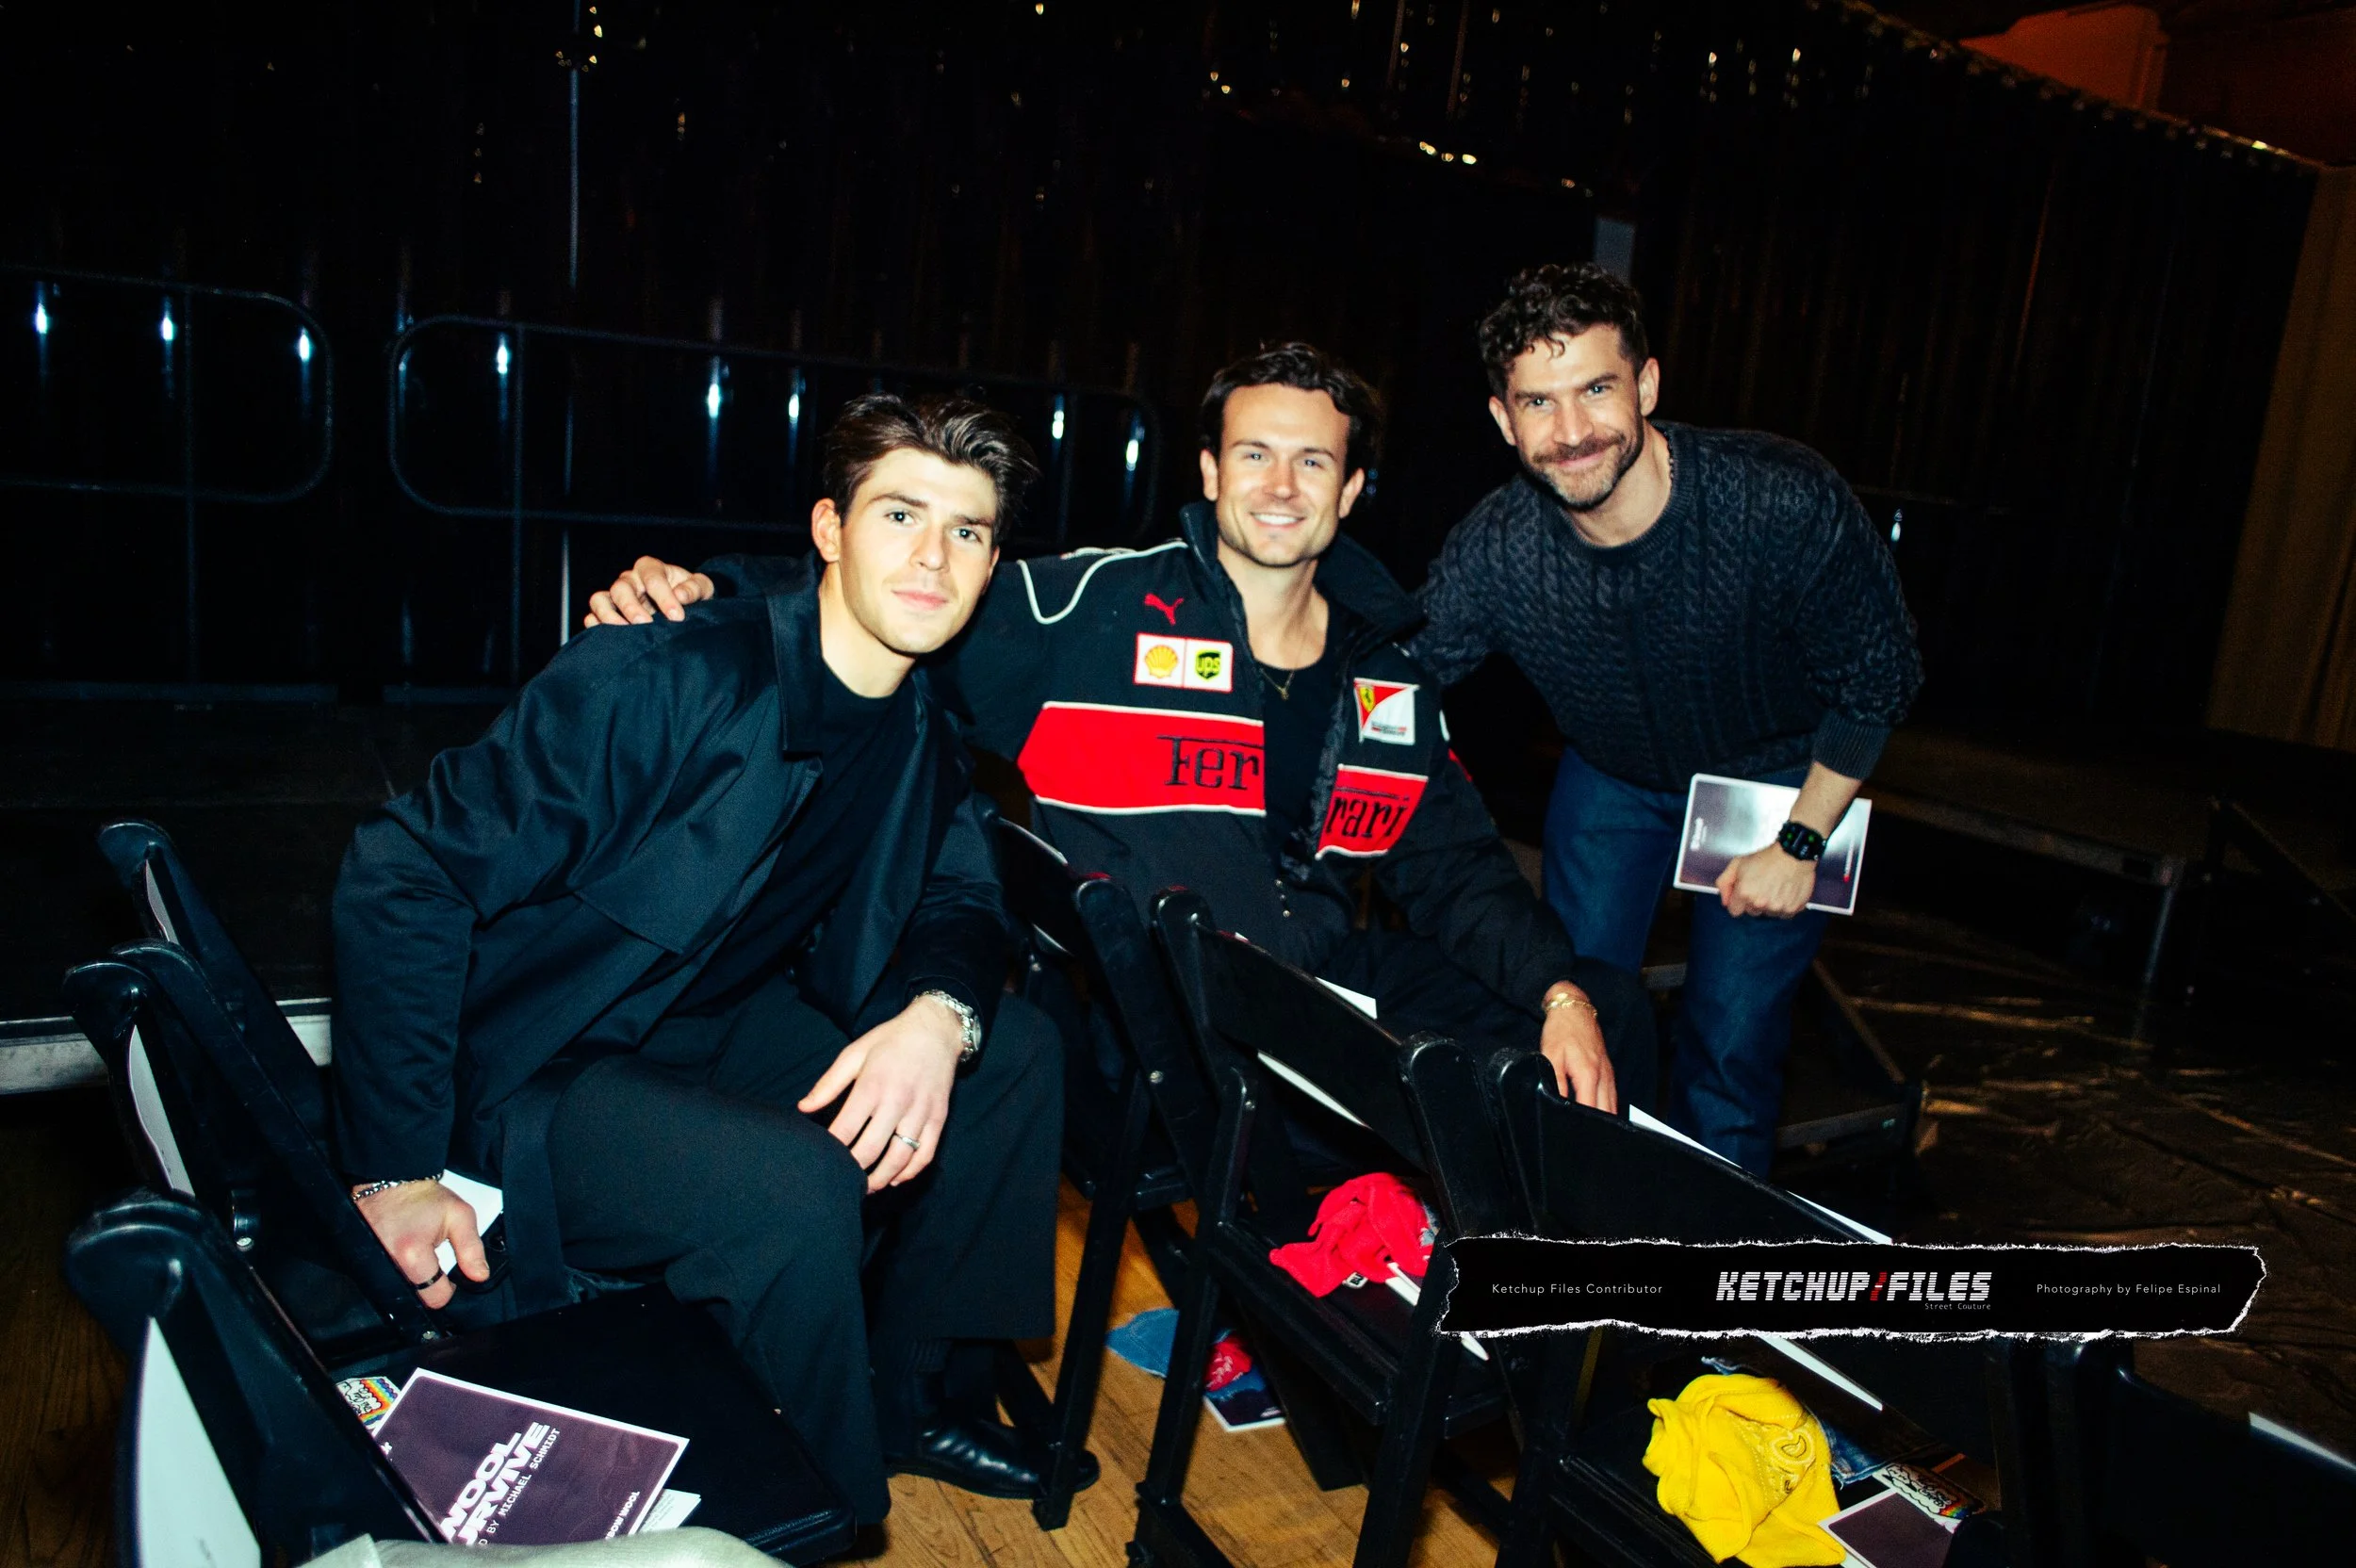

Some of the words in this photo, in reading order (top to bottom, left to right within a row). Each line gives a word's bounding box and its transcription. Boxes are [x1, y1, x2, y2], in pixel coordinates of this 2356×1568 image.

[1156, 735, 1264, 791] Fer
[1325, 787, 1411, 838] rari
[486, 1519, 499, 1534] BY
[498, 1474, 532, 1517] MICHAEL
[529, 1428, 561, 1470] SCHMIDT
[618, 1491, 640, 1516] WOOL
